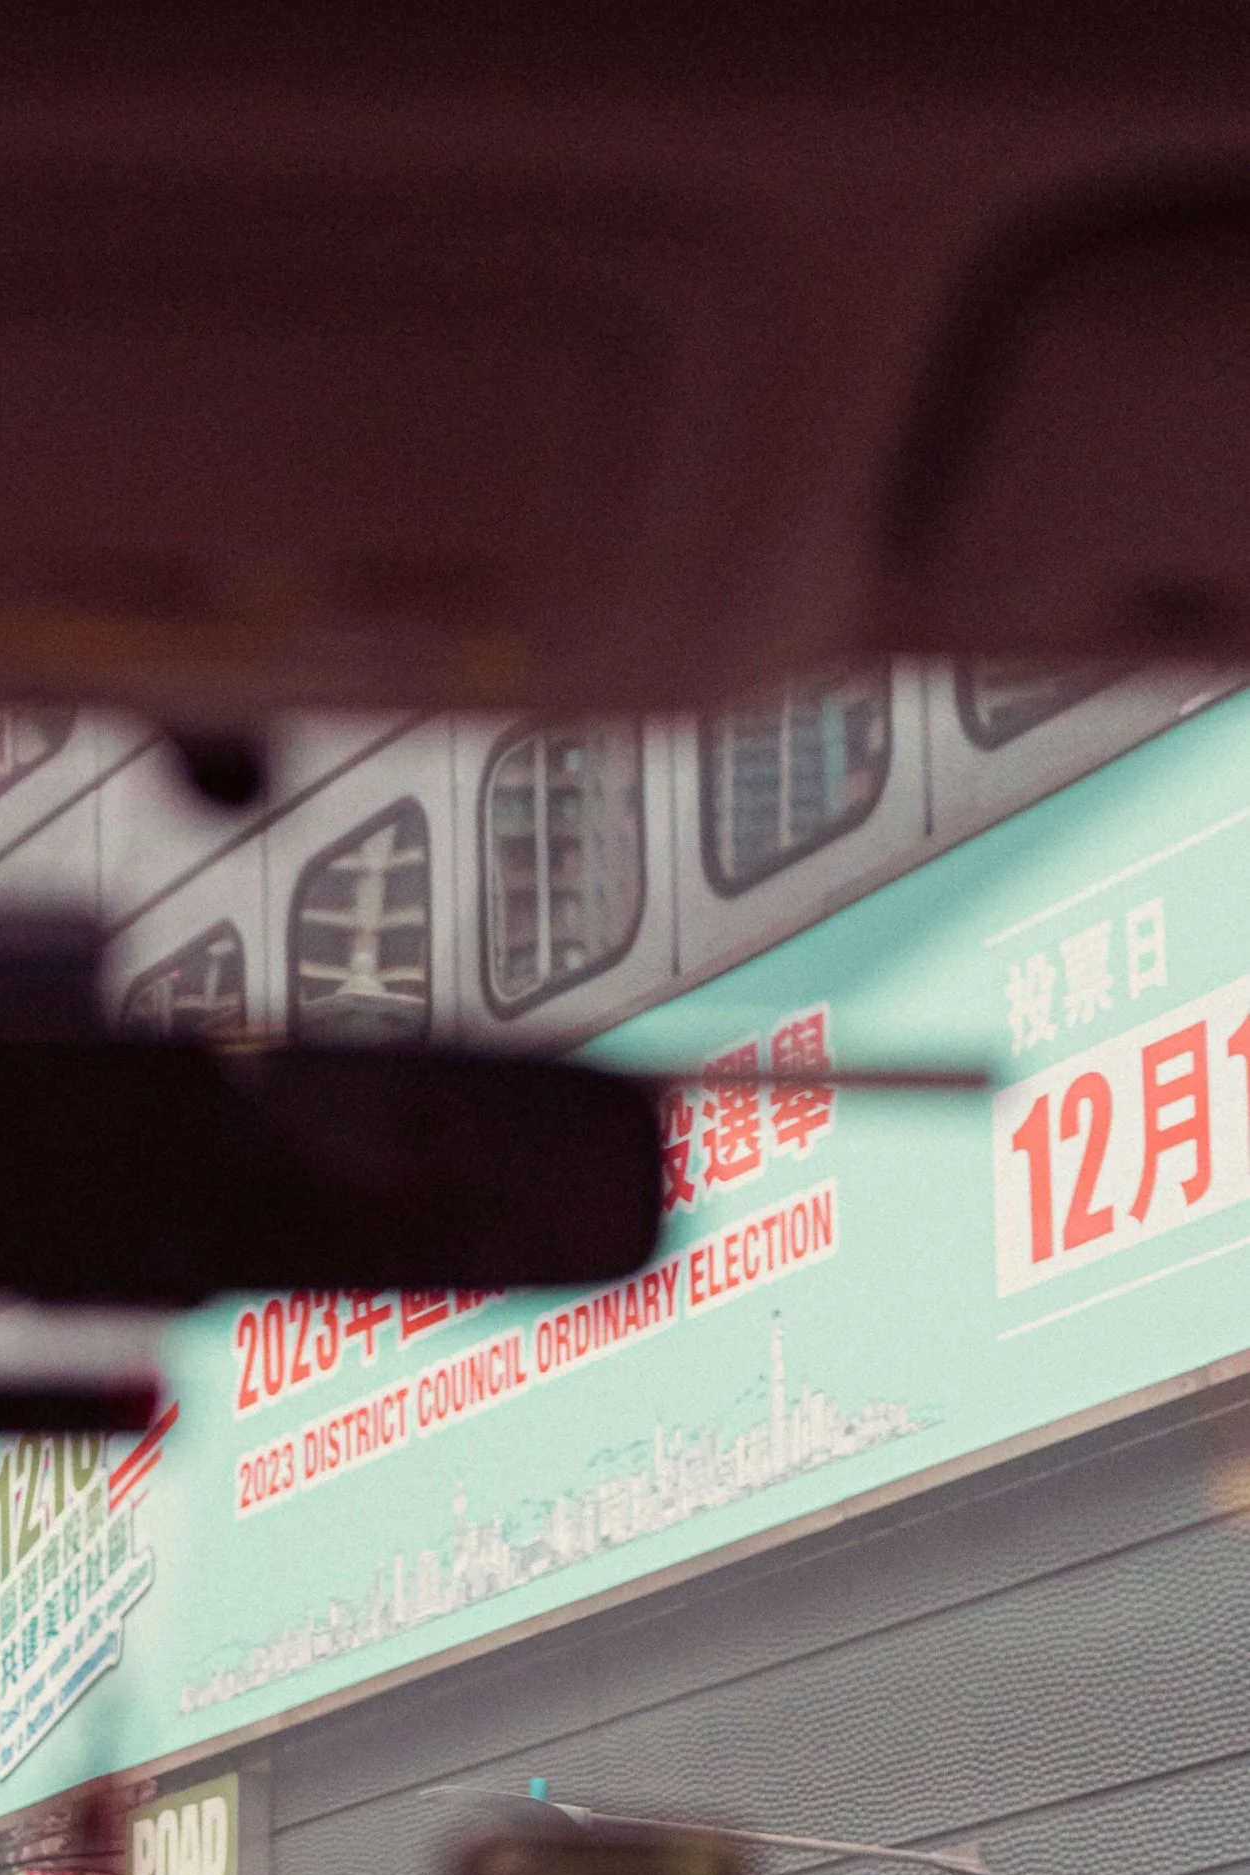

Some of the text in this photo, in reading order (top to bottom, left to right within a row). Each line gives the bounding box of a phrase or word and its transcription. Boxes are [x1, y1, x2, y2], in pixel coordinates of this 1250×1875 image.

[1005, 896, 1168, 1057] 投票日
[240, 1190, 834, 1510] 2023 DISTRICT COUNCIL ORDINARY ELECTION
